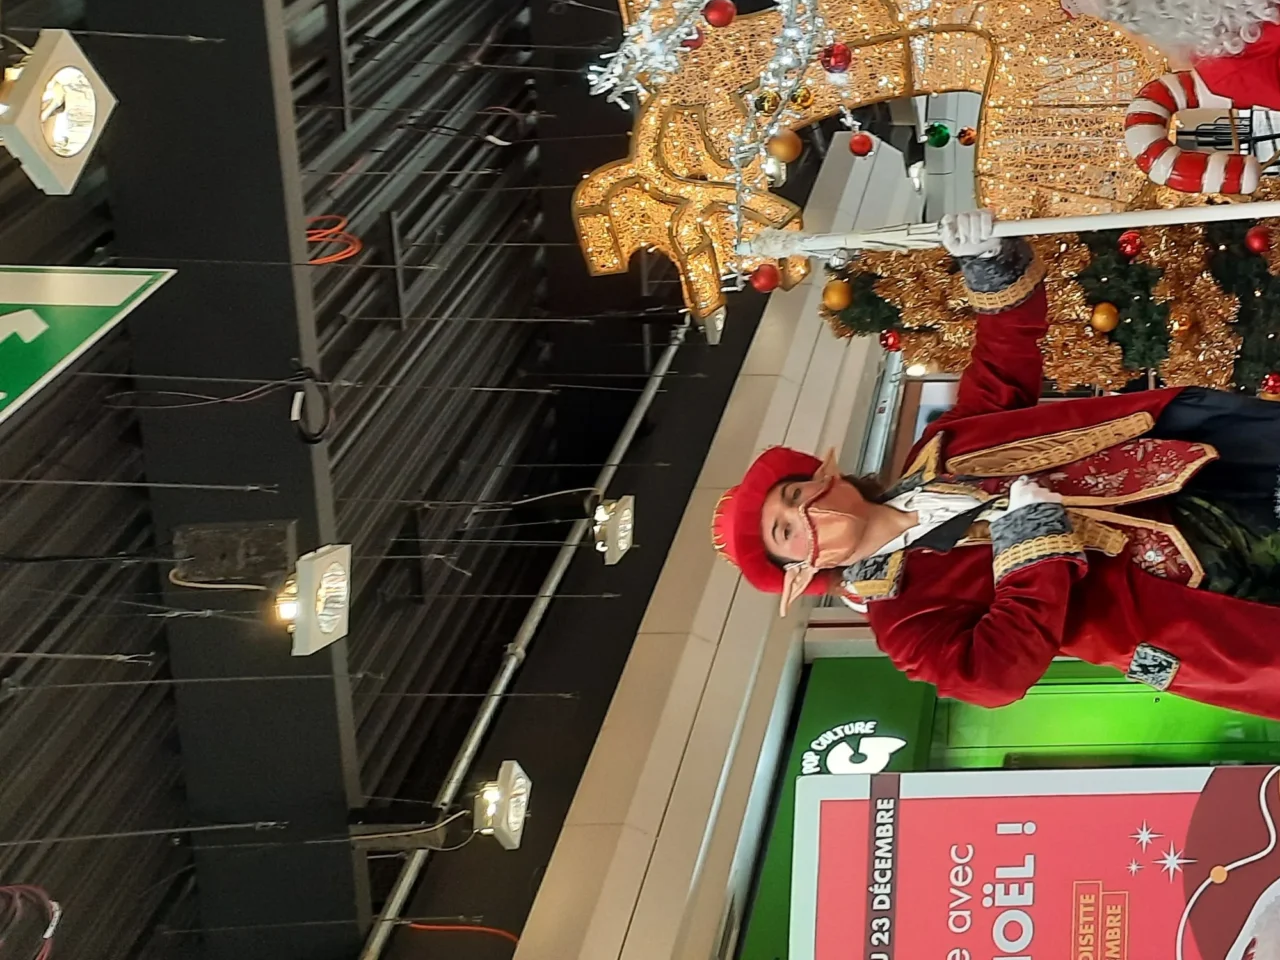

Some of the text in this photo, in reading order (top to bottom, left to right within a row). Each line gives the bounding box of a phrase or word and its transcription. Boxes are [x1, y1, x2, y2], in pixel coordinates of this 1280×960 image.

[802, 721, 877, 774] POP CULTURE
[868, 798, 895, 910] DÉCEMBRE
[948, 844, 974, 933] avec
[871, 917, 890, 946] 23
[982, 854, 1035, 960] OËL
[1105, 904, 1122, 960] MBRE
